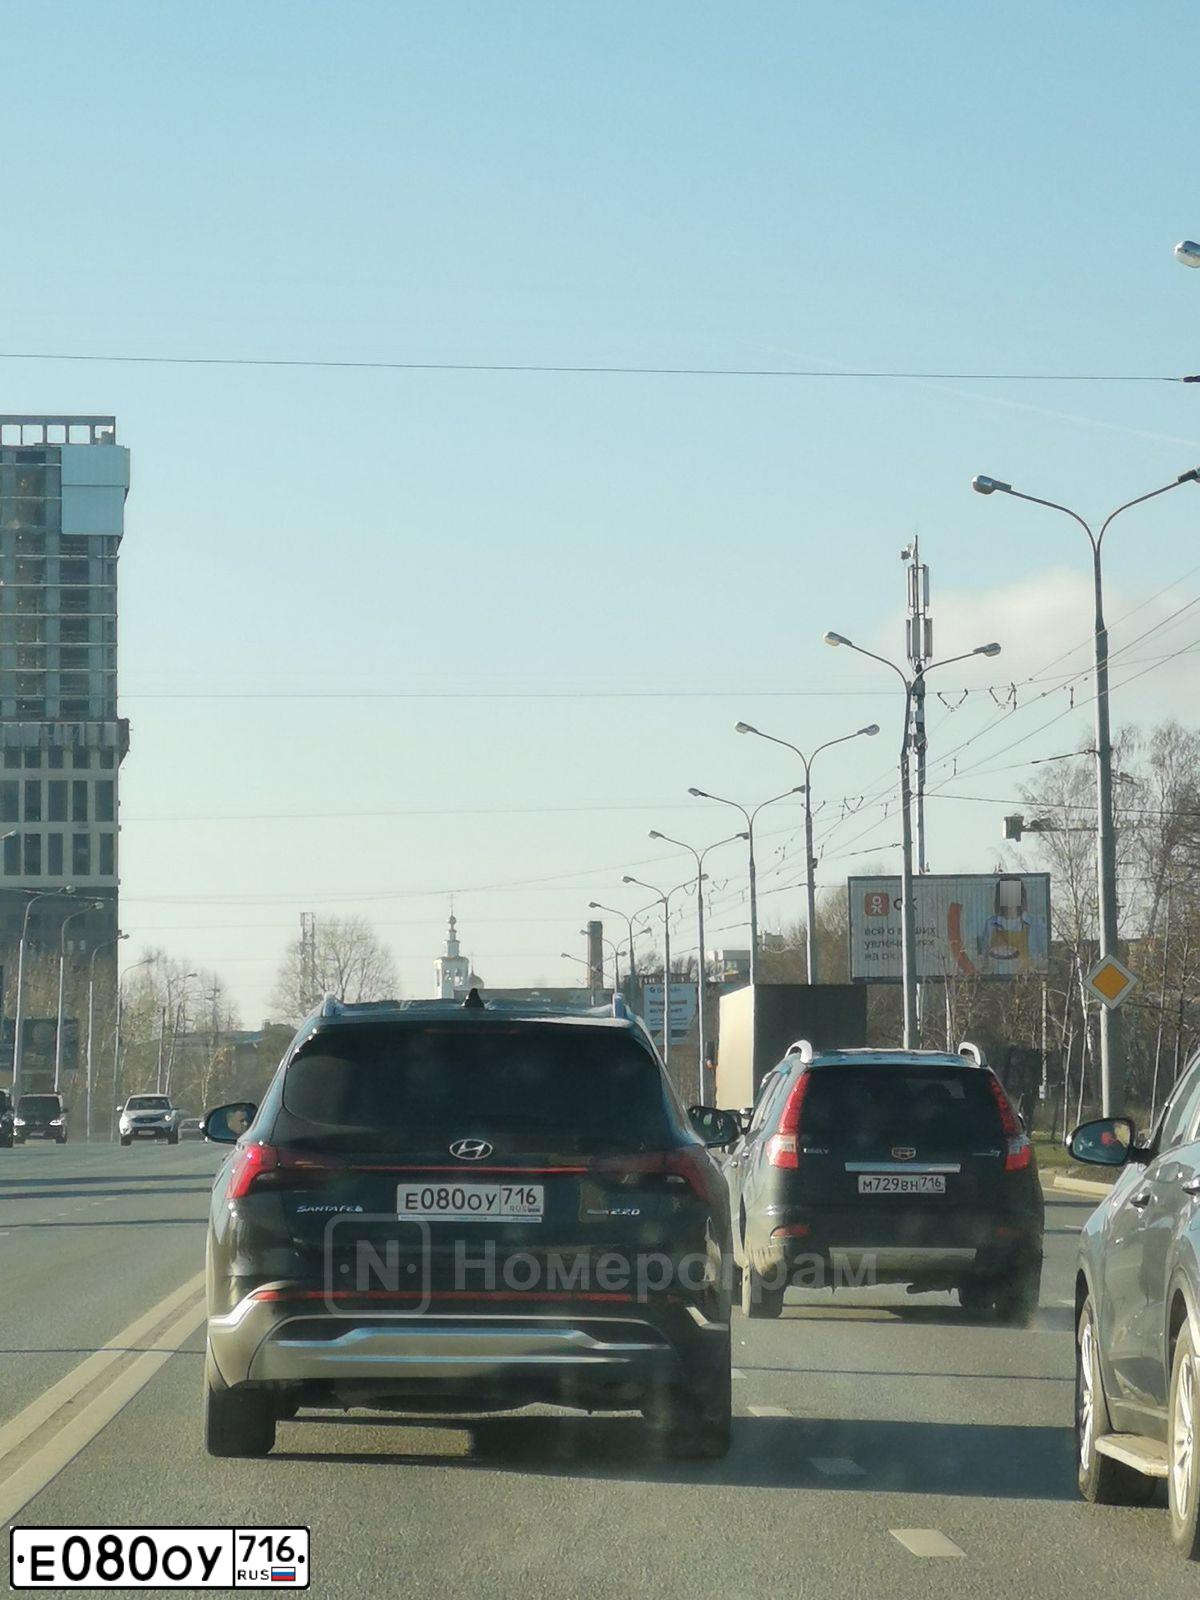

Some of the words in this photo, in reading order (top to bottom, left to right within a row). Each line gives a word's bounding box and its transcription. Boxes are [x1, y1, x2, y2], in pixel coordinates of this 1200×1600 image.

[862, 1178, 919, 1191] М729ВН
[921, 1177, 942, 1188] 716
[405, 1187, 497, 1211] Е080ОУ
[502, 1187, 537, 1206] 716
[509, 1205, 527, 1213] RUS
